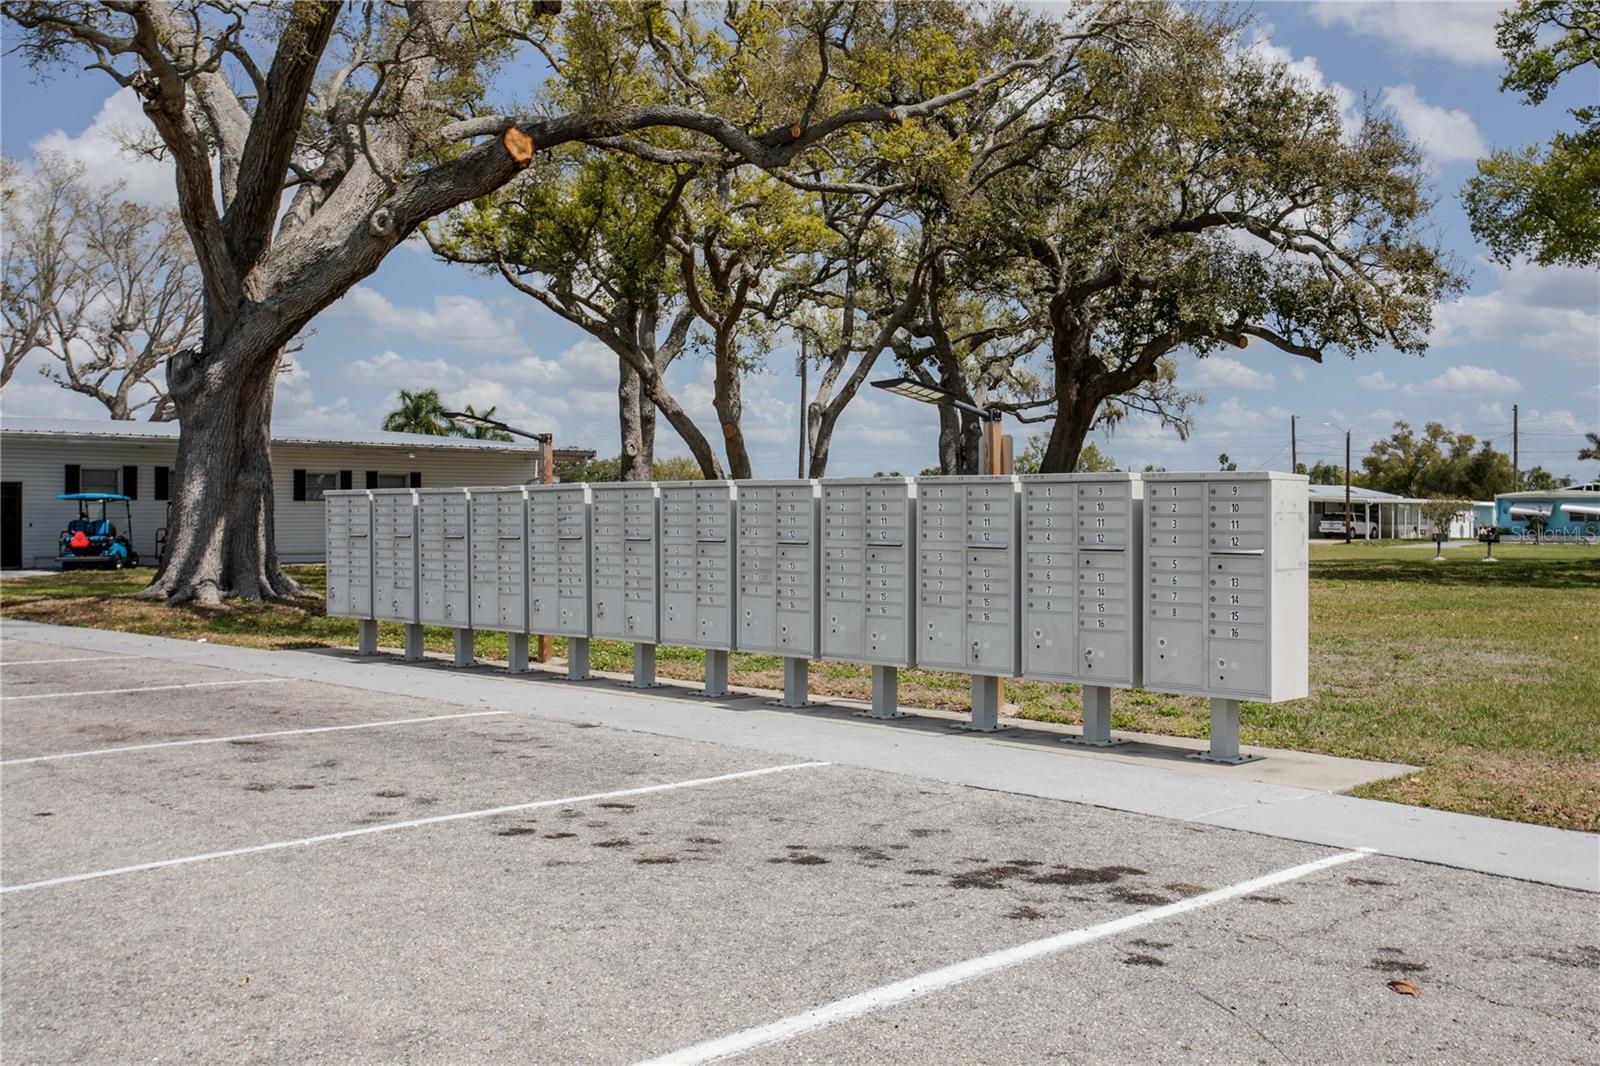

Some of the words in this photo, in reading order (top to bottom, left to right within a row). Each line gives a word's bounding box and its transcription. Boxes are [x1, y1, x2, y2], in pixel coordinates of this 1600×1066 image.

[983, 503, 990, 512] 10
[1097, 502, 1105, 511] 10
[1231, 503, 1240, 513] 10
[983, 518, 990, 526] 11
[1097, 518, 1105, 527] 11
[1231, 520, 1239, 530] 11
[983, 532, 990, 541] 12
[1097, 534, 1104, 543] 12
[1231, 536, 1239, 546] 12
[983, 569, 990, 578] 13
[1098, 573, 1105, 582] 13
[983, 583, 990, 592] 14
[1231, 578, 1239, 588] 13
[1098, 588, 1105, 597] 14
[983, 598, 990, 606] 15
[1231, 594, 1239, 604] 14
[1098, 603, 1105, 612] 15
[983, 612, 990, 621] 16
[1231, 611, 1239, 621] 15
[1098, 619, 1105, 628] 16
[1231, 628, 1239, 638] 16
